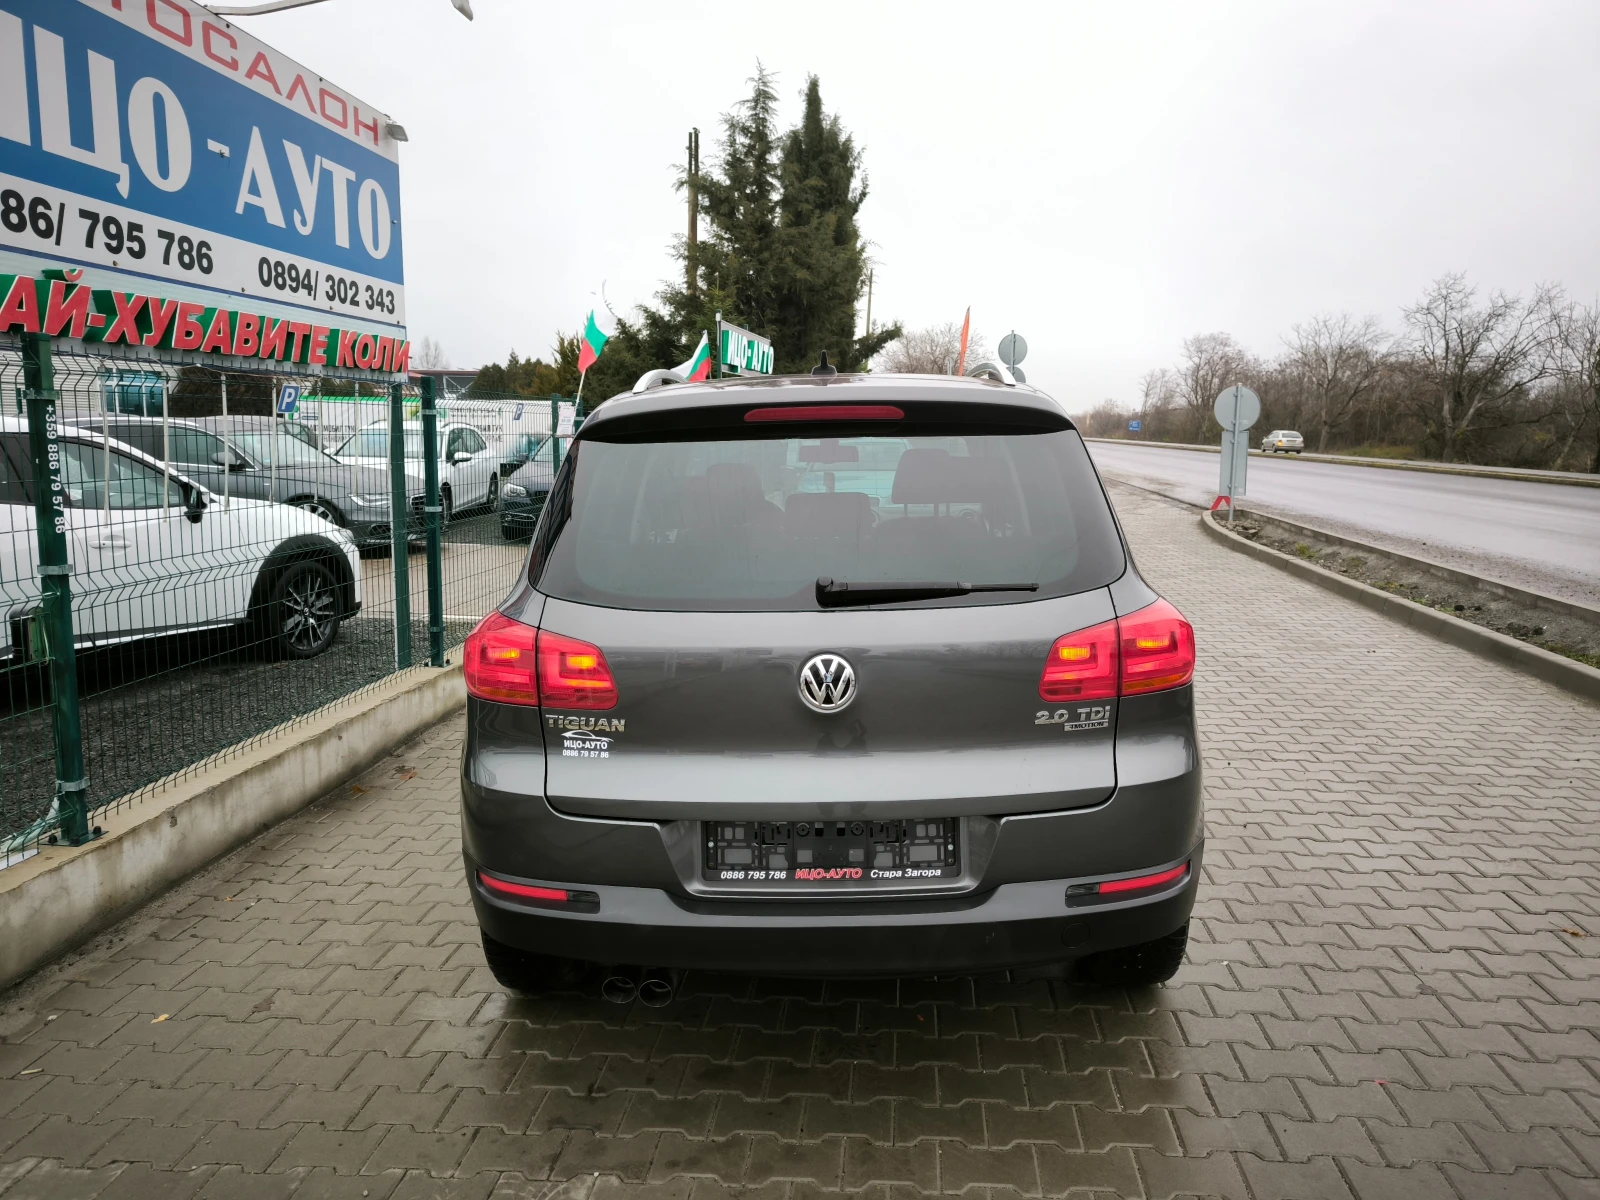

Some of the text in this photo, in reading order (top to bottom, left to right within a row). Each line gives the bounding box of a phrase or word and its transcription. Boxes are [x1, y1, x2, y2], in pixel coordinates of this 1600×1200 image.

[110, 0, 380, 147] ОСАЛОН
[78, 208, 146, 260] 795
[157, 229, 214, 275] 786
[258, 257, 396, 315] 0894/ 302 343
[336, 329, 410, 374] КОЛИ
[727, 329, 774, 375] ИЦО-АУТО
[45, 404, 65, 534] +359 886 79 57 86
[545, 714, 626, 732] TIGUAN
[562, 749, 579, 757] 0886
[600, 751, 609, 759] 86
[563, 739, 608, 750] ИЦО-АУТО
[720, 871, 787, 880] 0886 795 786
[795, 868, 863, 880] ИЦО-АУТО
[870, 868, 941, 879] Стара Загора
